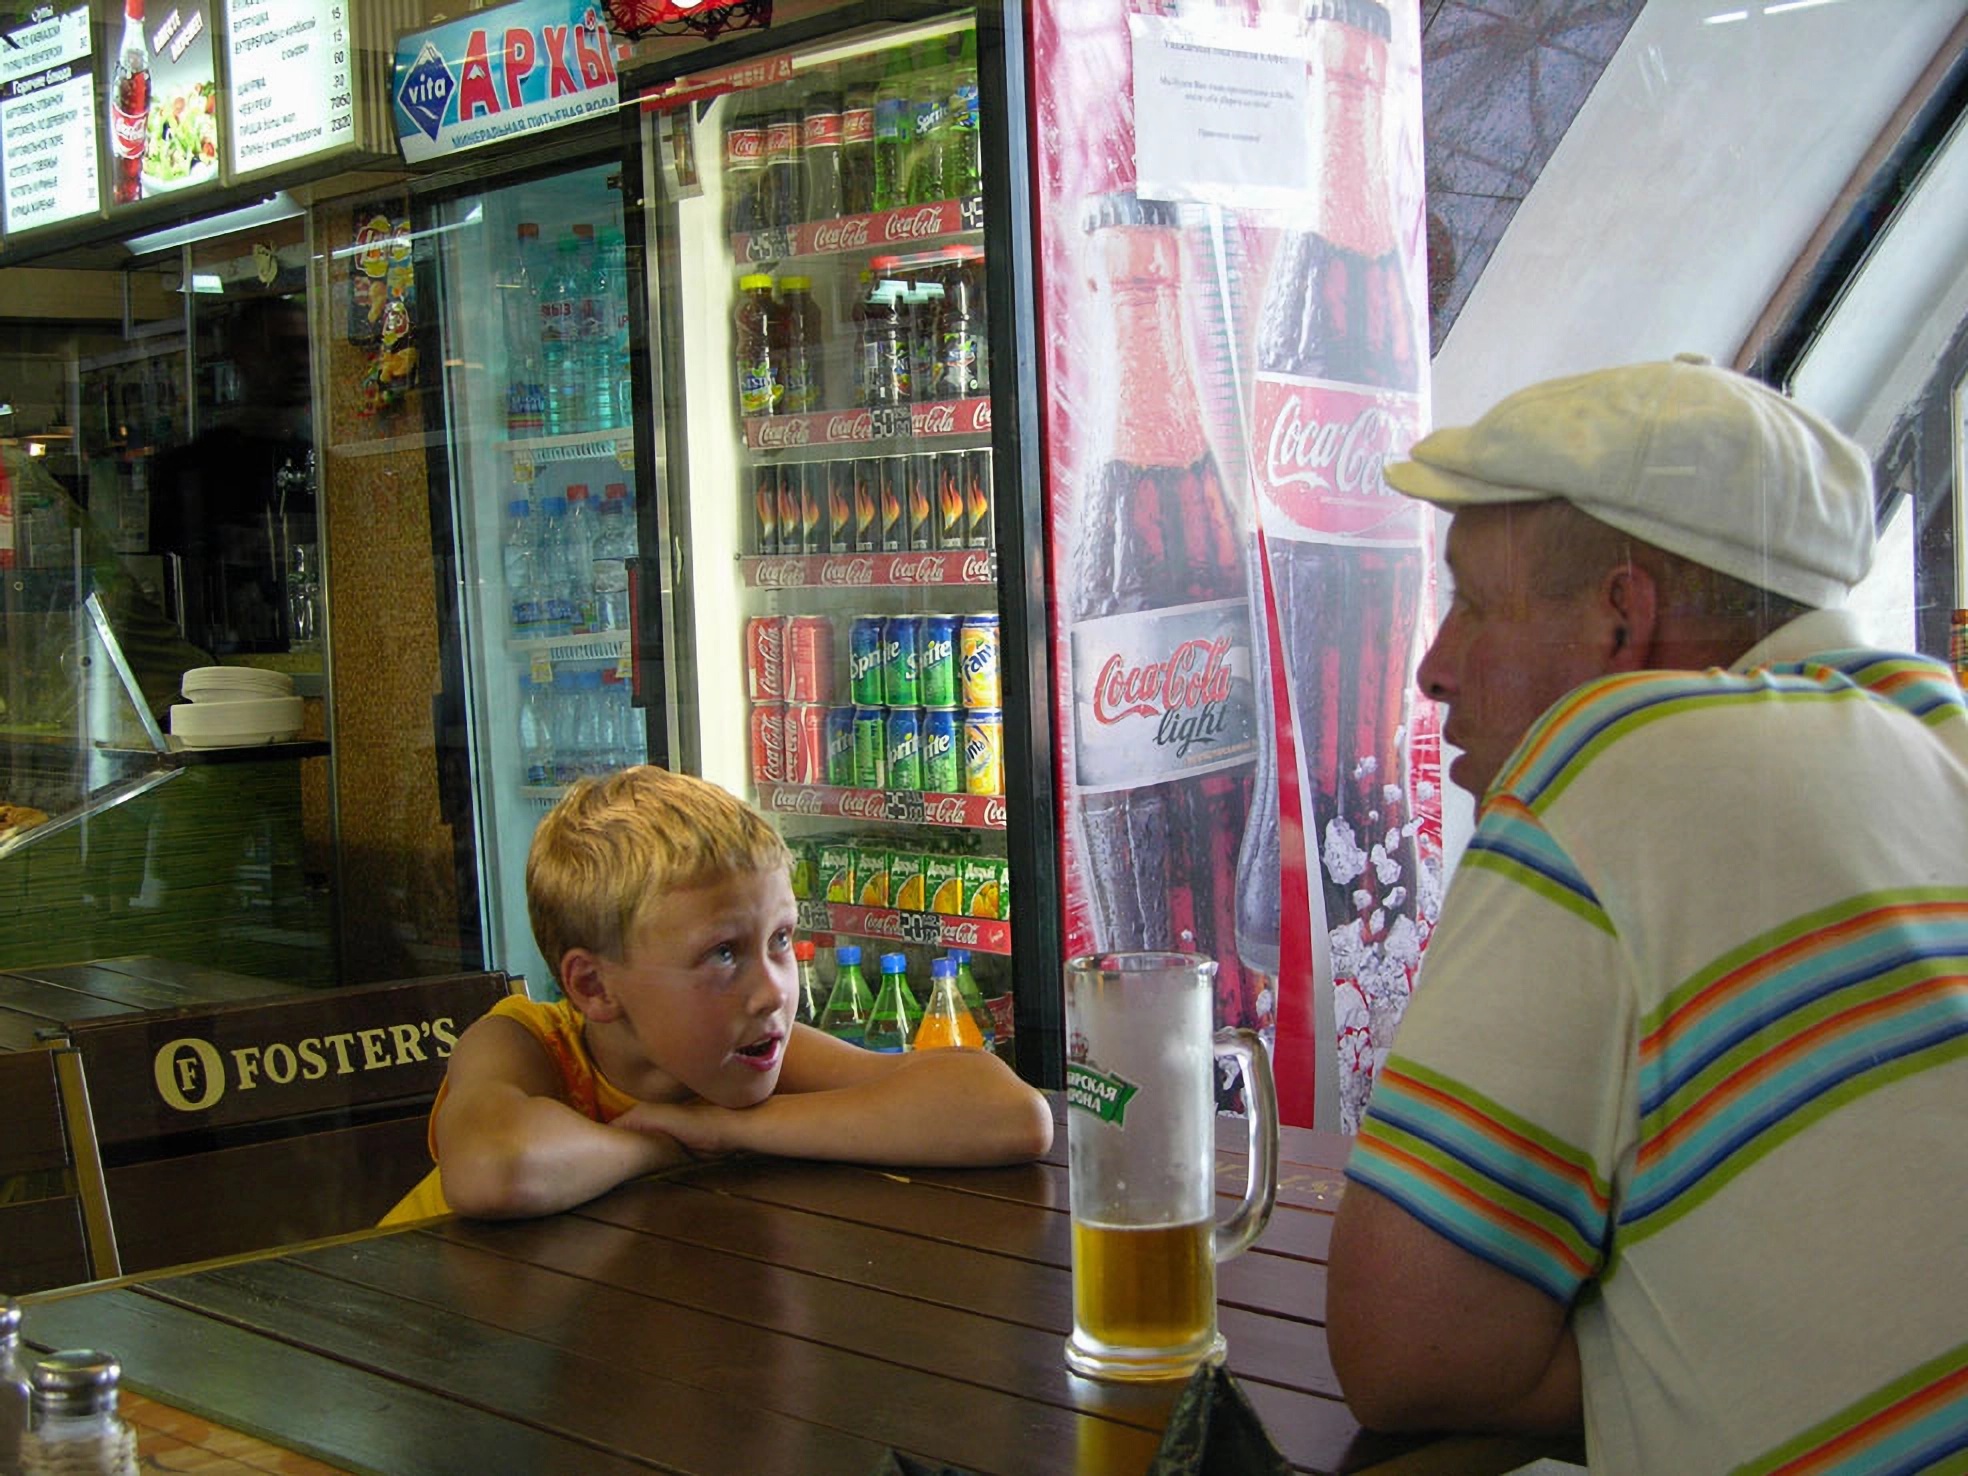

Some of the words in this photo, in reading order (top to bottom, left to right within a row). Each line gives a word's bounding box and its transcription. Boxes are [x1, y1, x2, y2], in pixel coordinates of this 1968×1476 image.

[408, 74, 447, 104] vita
[459, 23, 617, 121] АРХЫ
[1152, 700, 1228, 759] light
[231, 1017, 459, 1091] FOSTER'S
